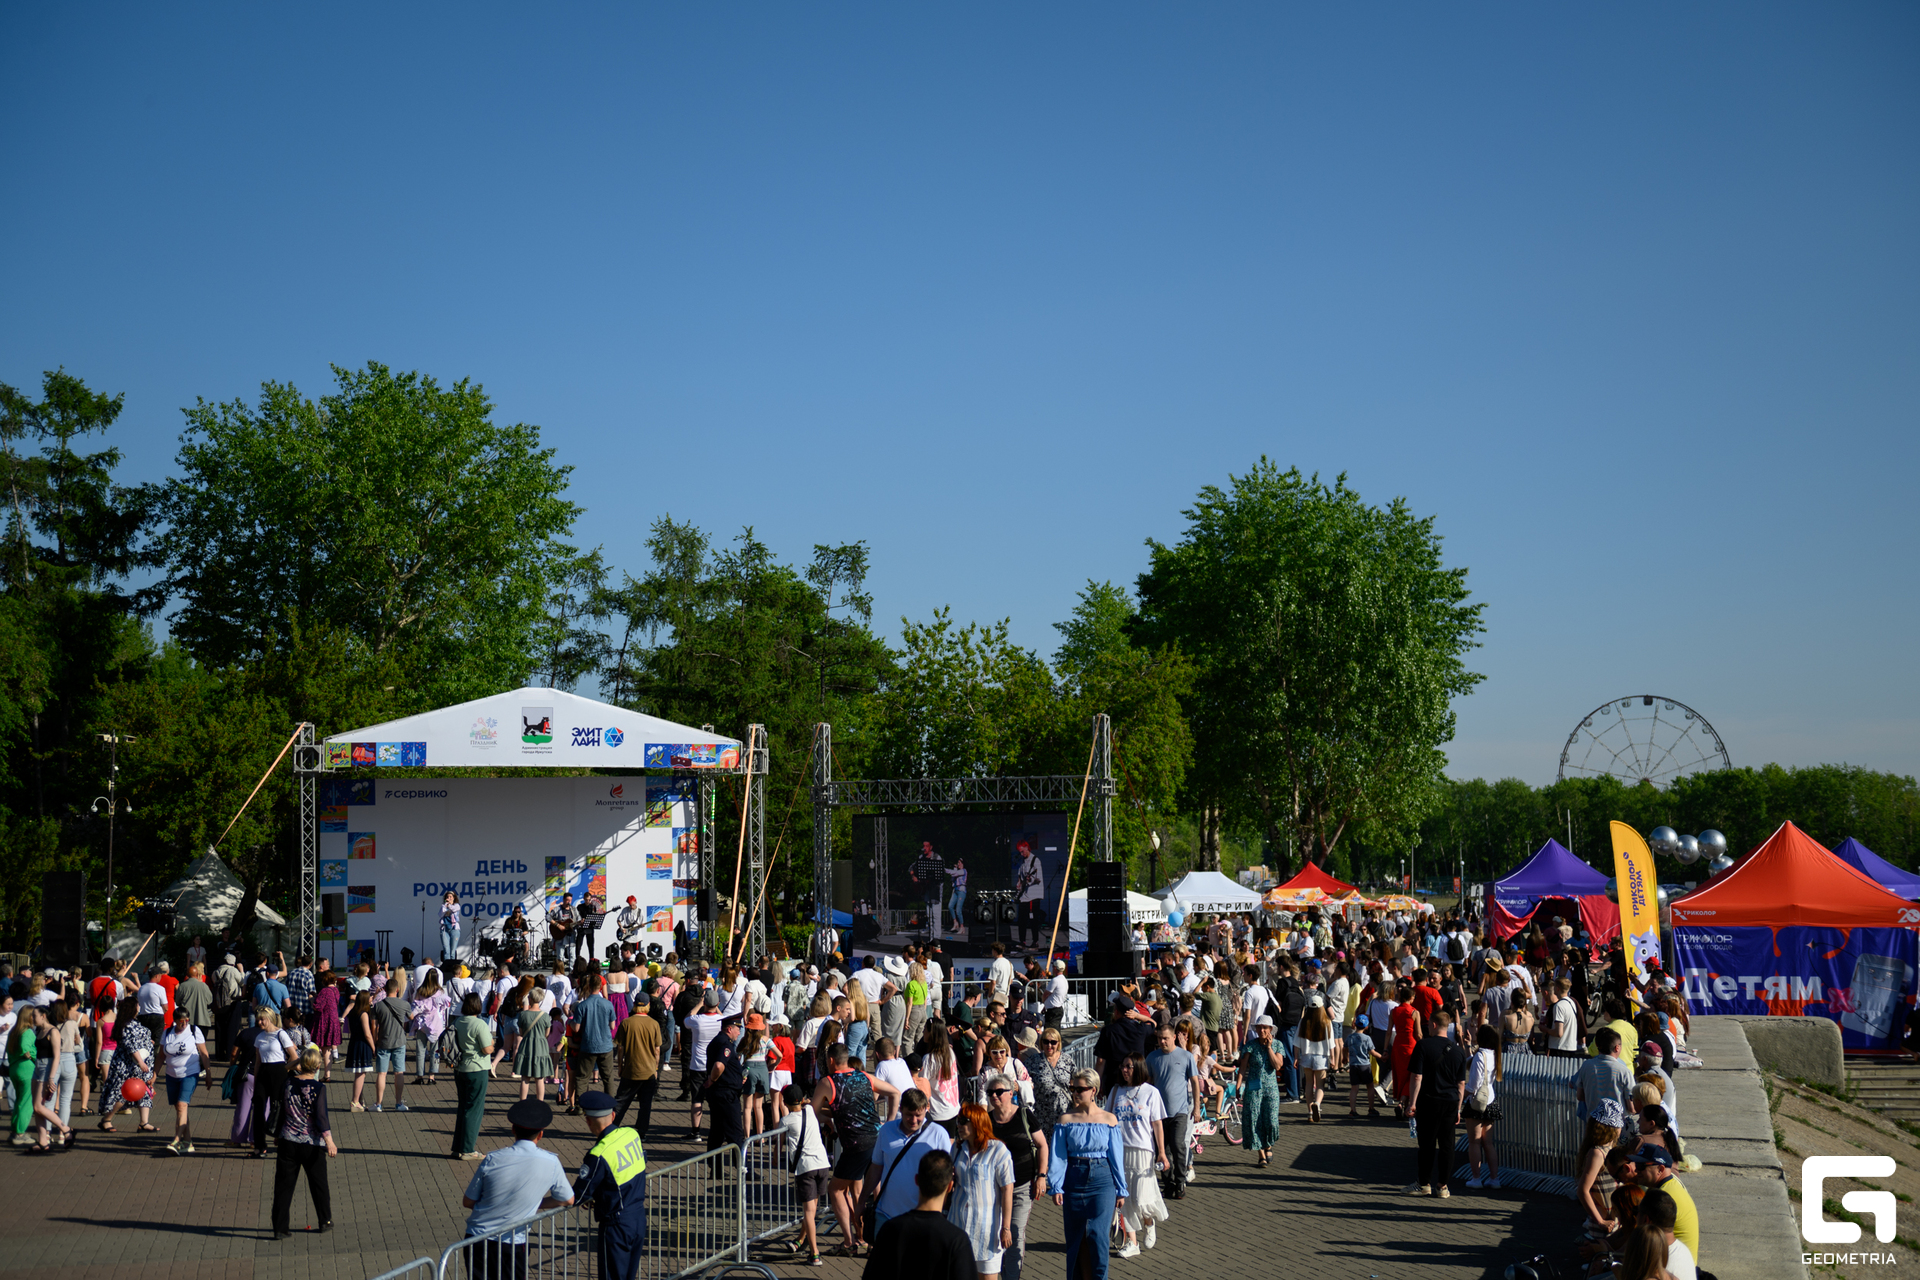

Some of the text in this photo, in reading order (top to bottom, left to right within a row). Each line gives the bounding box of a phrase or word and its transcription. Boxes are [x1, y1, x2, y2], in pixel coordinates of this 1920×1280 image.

[571, 727, 603, 737] ЭЛИТ
[571, 737, 600, 747] ЛАЙН
[393, 790, 448, 799] сервико
[475, 859, 528, 876] ДЕНЬ
[413, 880, 528, 898] РОЖДЕНИЯ
[1628, 860, 1640, 917] ТРИКОЛОР
[1636, 870, 1646, 907] ДЕТЯМ
[460, 902, 528, 918] ОРОДА
[1191, 902, 1253, 912] КВАГРИМ
[1683, 967, 1822, 1007] Детям
